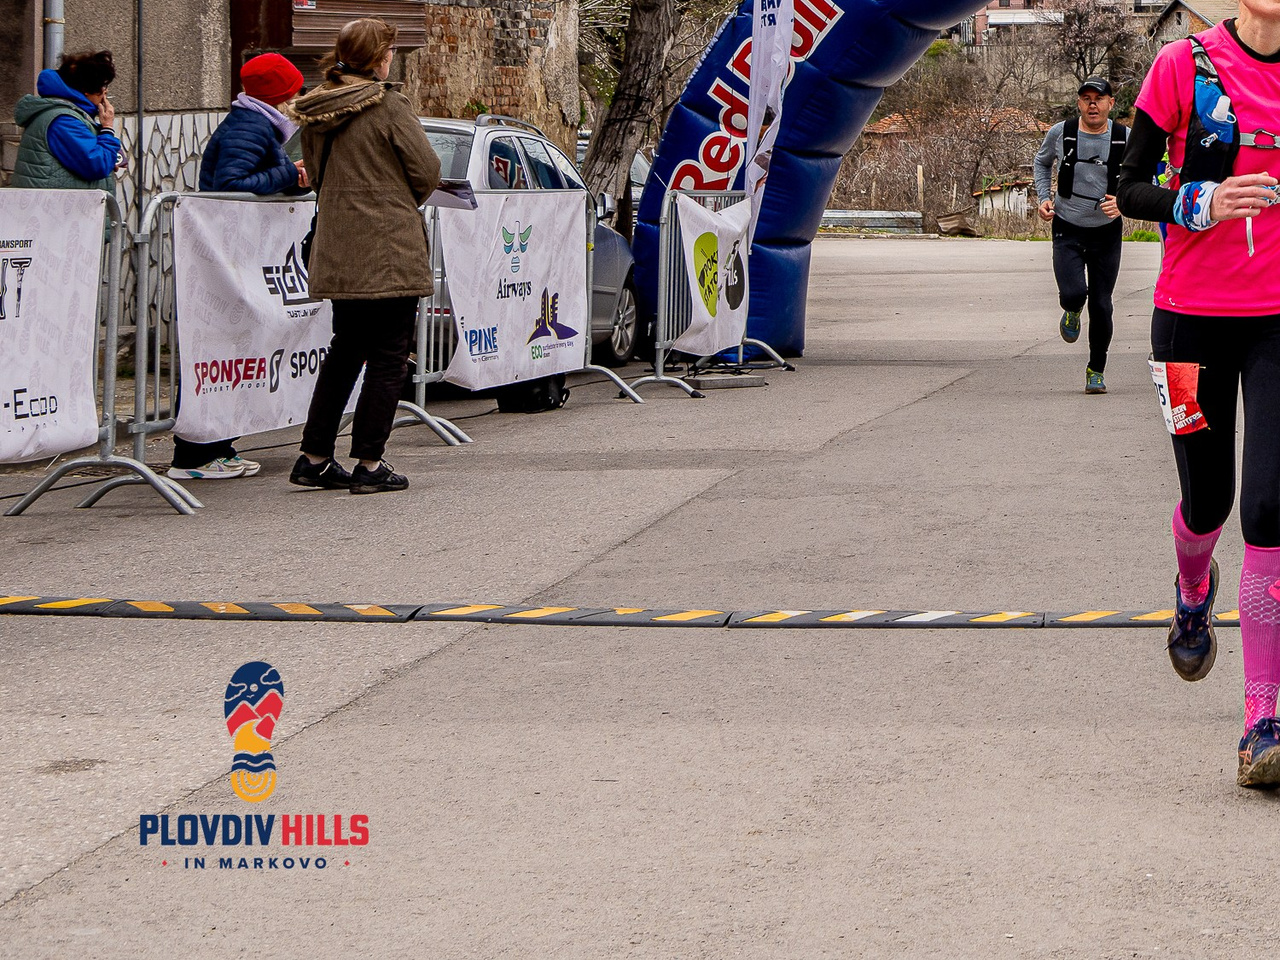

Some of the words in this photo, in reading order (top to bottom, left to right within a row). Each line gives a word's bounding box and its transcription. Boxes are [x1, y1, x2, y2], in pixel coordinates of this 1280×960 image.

[668, 78, 748, 191] Red
[497, 279, 532, 301] Airways
[531, 344, 543, 360] ECO
